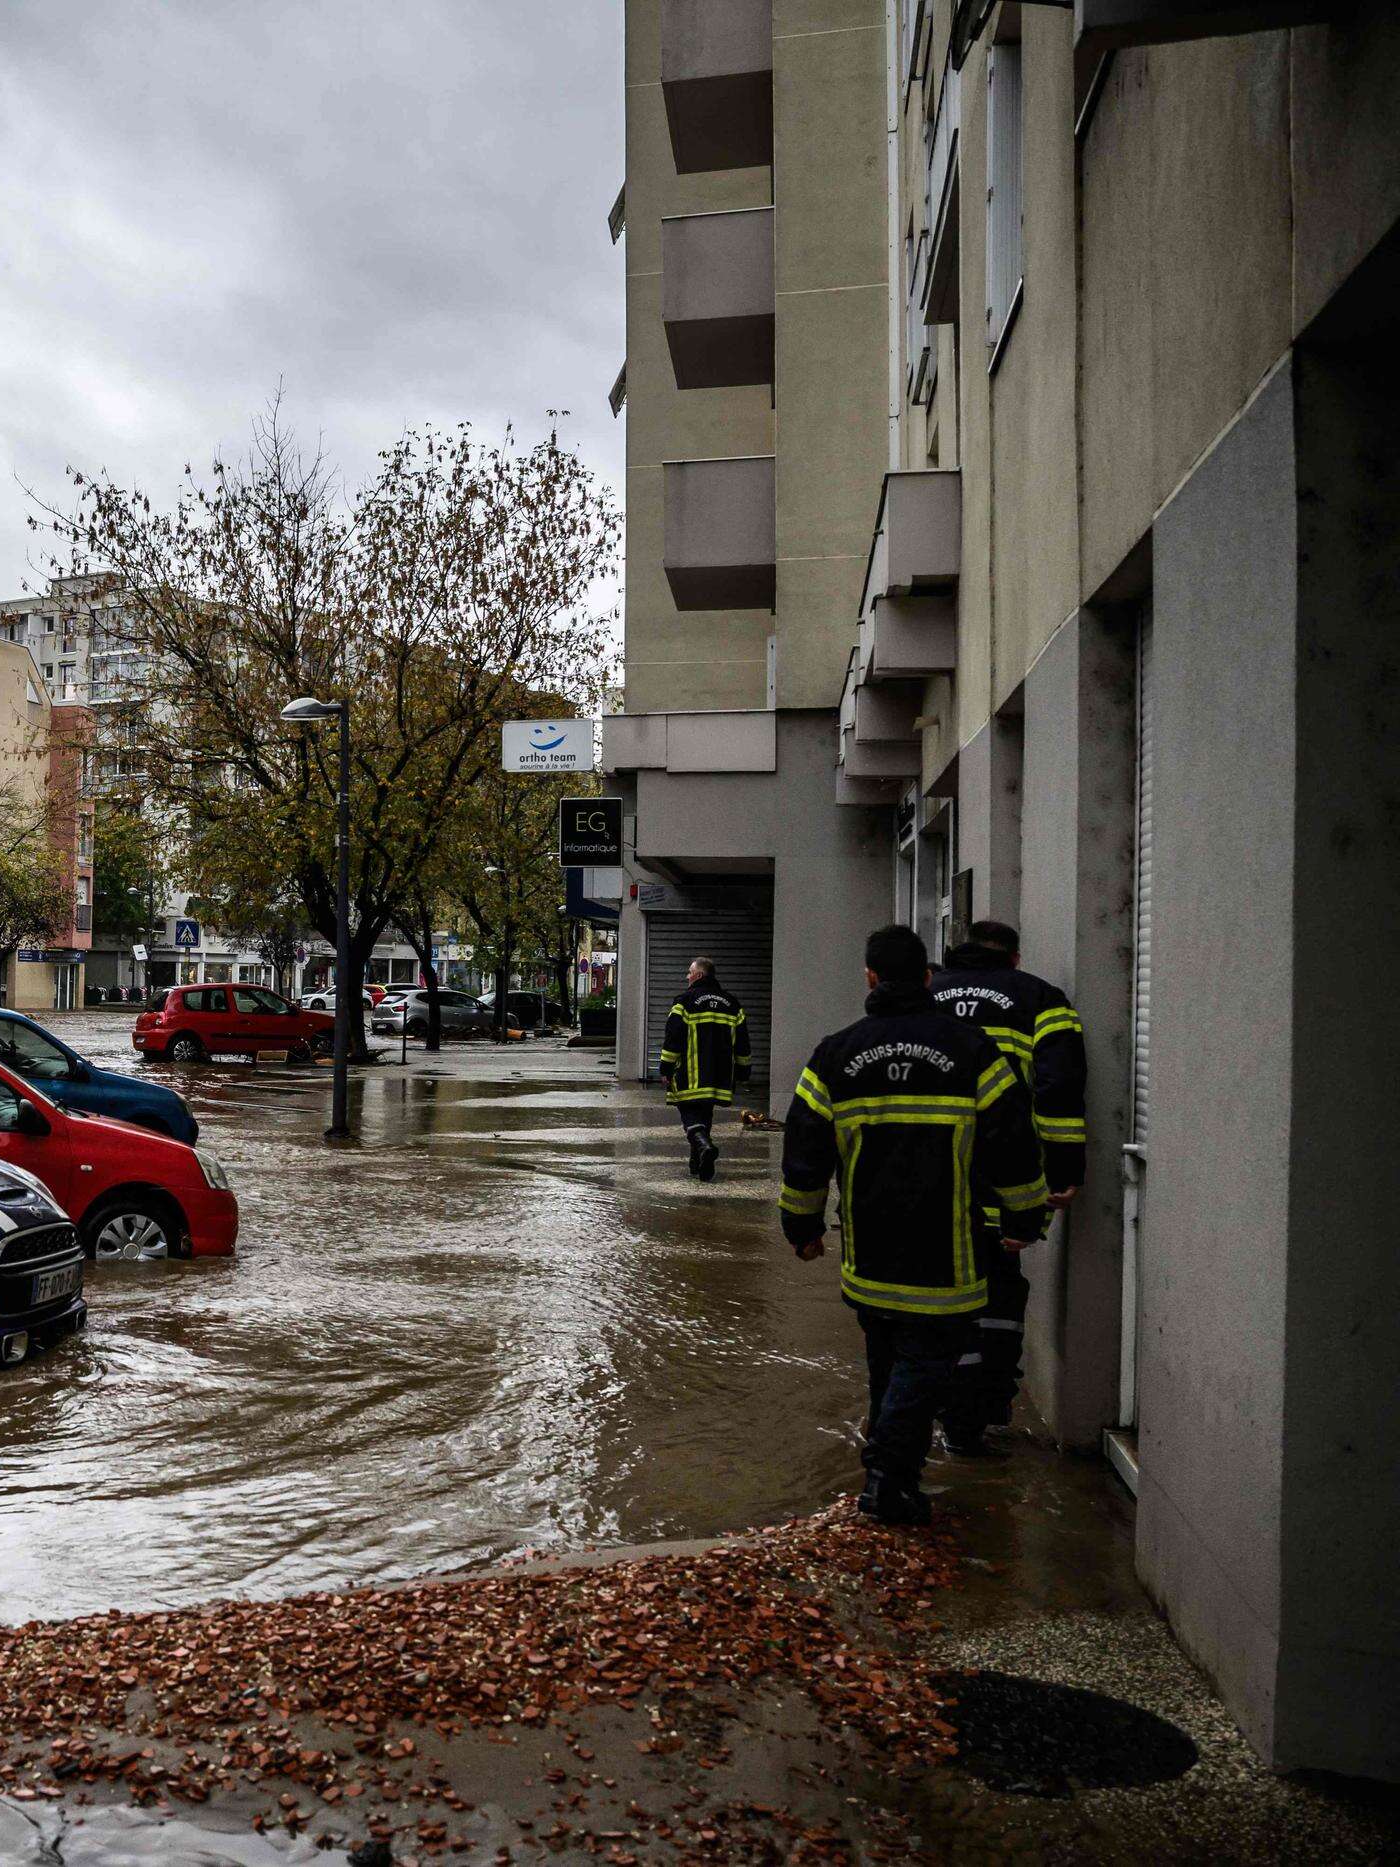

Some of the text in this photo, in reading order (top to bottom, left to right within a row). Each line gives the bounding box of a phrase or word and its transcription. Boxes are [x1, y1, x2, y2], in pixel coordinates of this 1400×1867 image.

[519, 752, 576, 762] ortho team
[576, 812, 606, 832] EG
[955, 1000, 979, 1017] 07
[843, 1042, 955, 1077] SAPEURS-POMPIERS
[887, 1062, 913, 1081] 07
